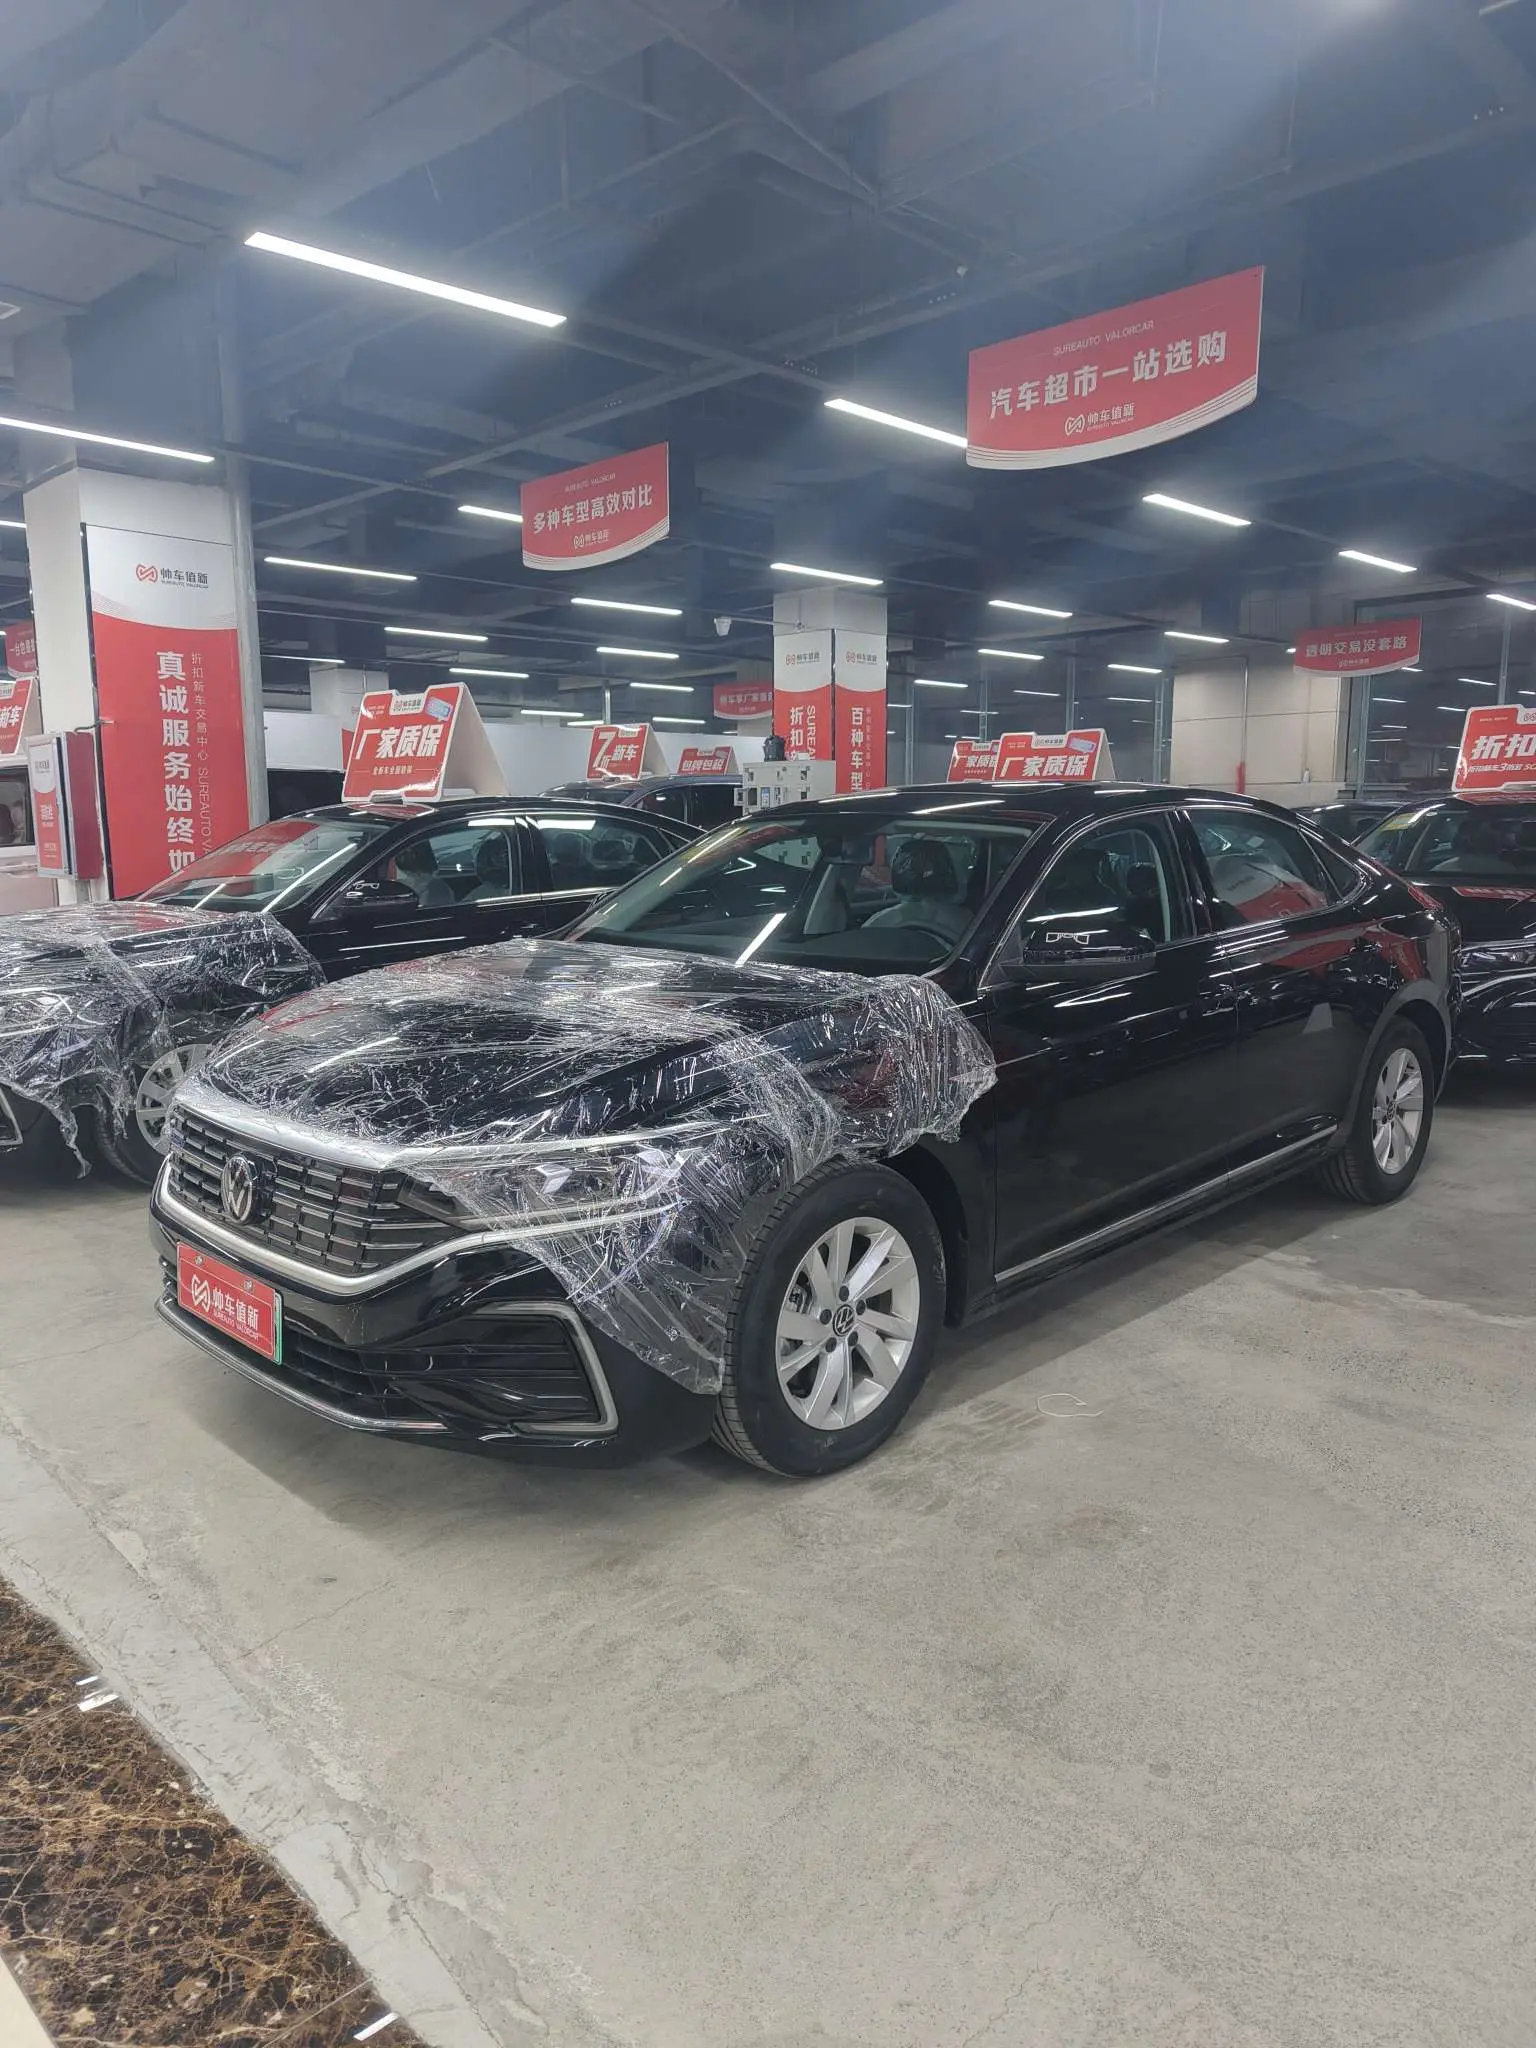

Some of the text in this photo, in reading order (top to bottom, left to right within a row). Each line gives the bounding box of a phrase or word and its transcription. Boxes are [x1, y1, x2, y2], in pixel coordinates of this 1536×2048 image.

[1053, 320, 1154, 356] SUREAUTO VALORCAR
[990, 330, 1227, 420] 汽车超市一站选购
[1087, 403, 1135, 426] 帅车值新
[533, 484, 653, 535] 多种车型高效对比
[161, 567, 208, 584] 帅车值新
[1305, 636, 1408, 657] 透明交易没套路
[191, 653, 208, 761] 折扣新车交易中心
[156, 650, 196, 873] 真诚服务始终如
[355, 724, 444, 760] 厂家质保
[851, 707, 864, 792] 百种车型
[1000, 755, 1090, 777] 厂家质保
[198, 767, 212, 837] SUREAUTO
[212, 1286, 259, 1331] 帅车值新
